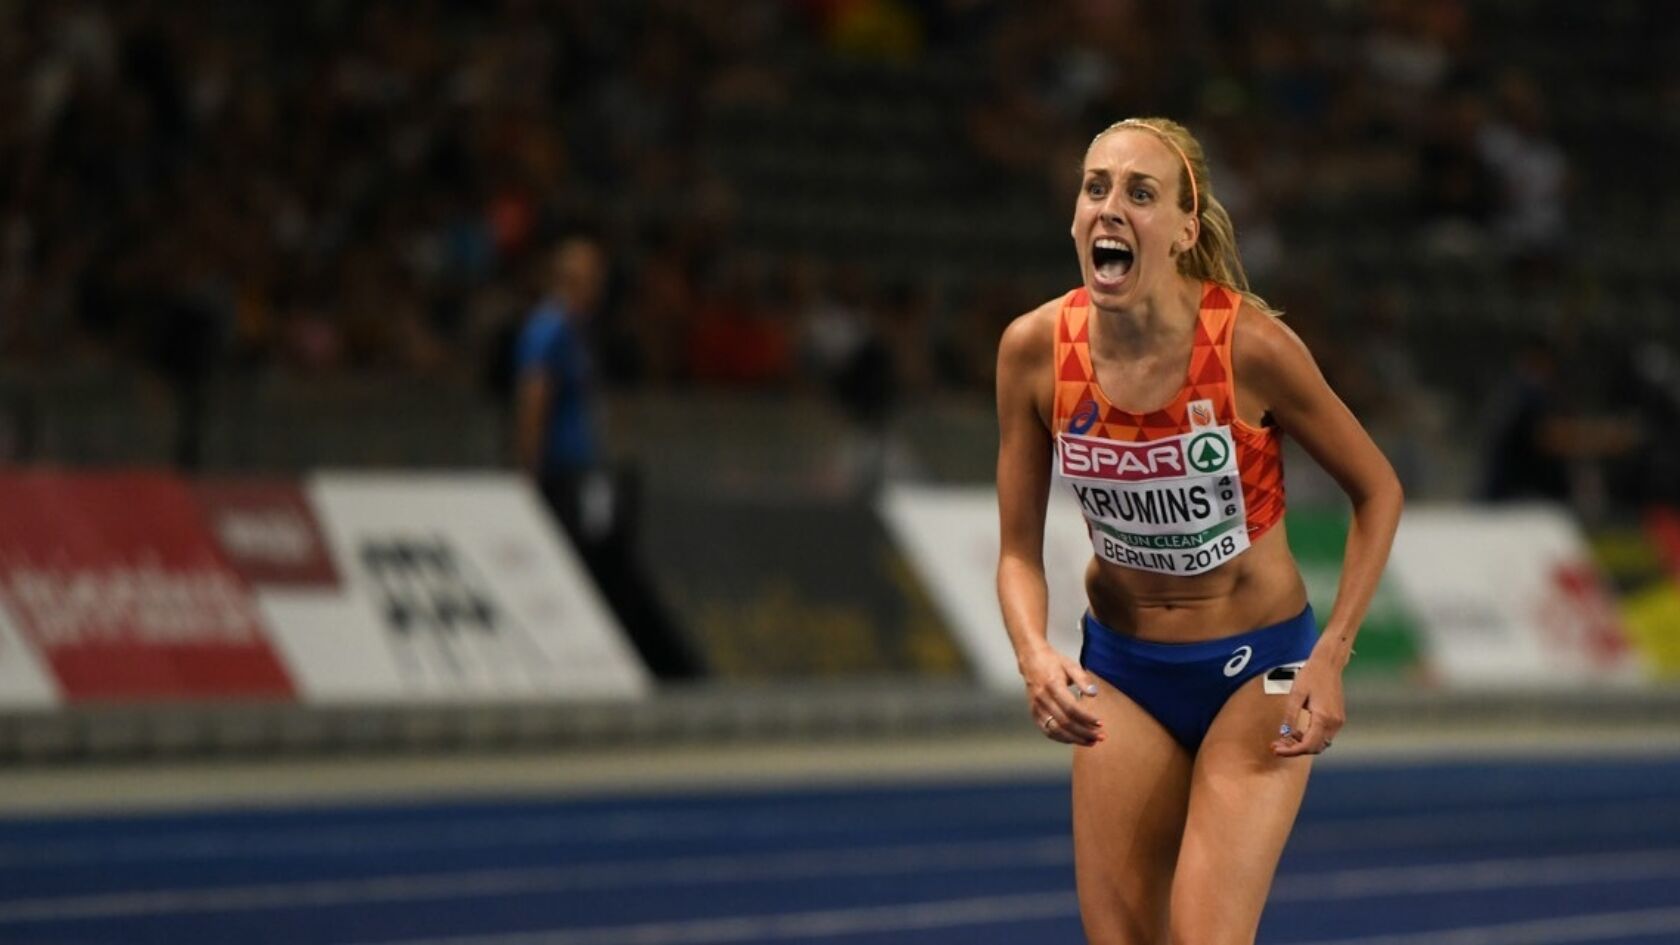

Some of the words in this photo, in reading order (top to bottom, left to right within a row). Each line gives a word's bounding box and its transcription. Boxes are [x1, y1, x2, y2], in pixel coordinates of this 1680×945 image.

[1065, 445, 1181, 475] SPAR
[1072, 484, 1211, 525] KRUMINS
[1103, 538, 1176, 571] BERLIN
[1183, 536, 1236, 571] 2018
